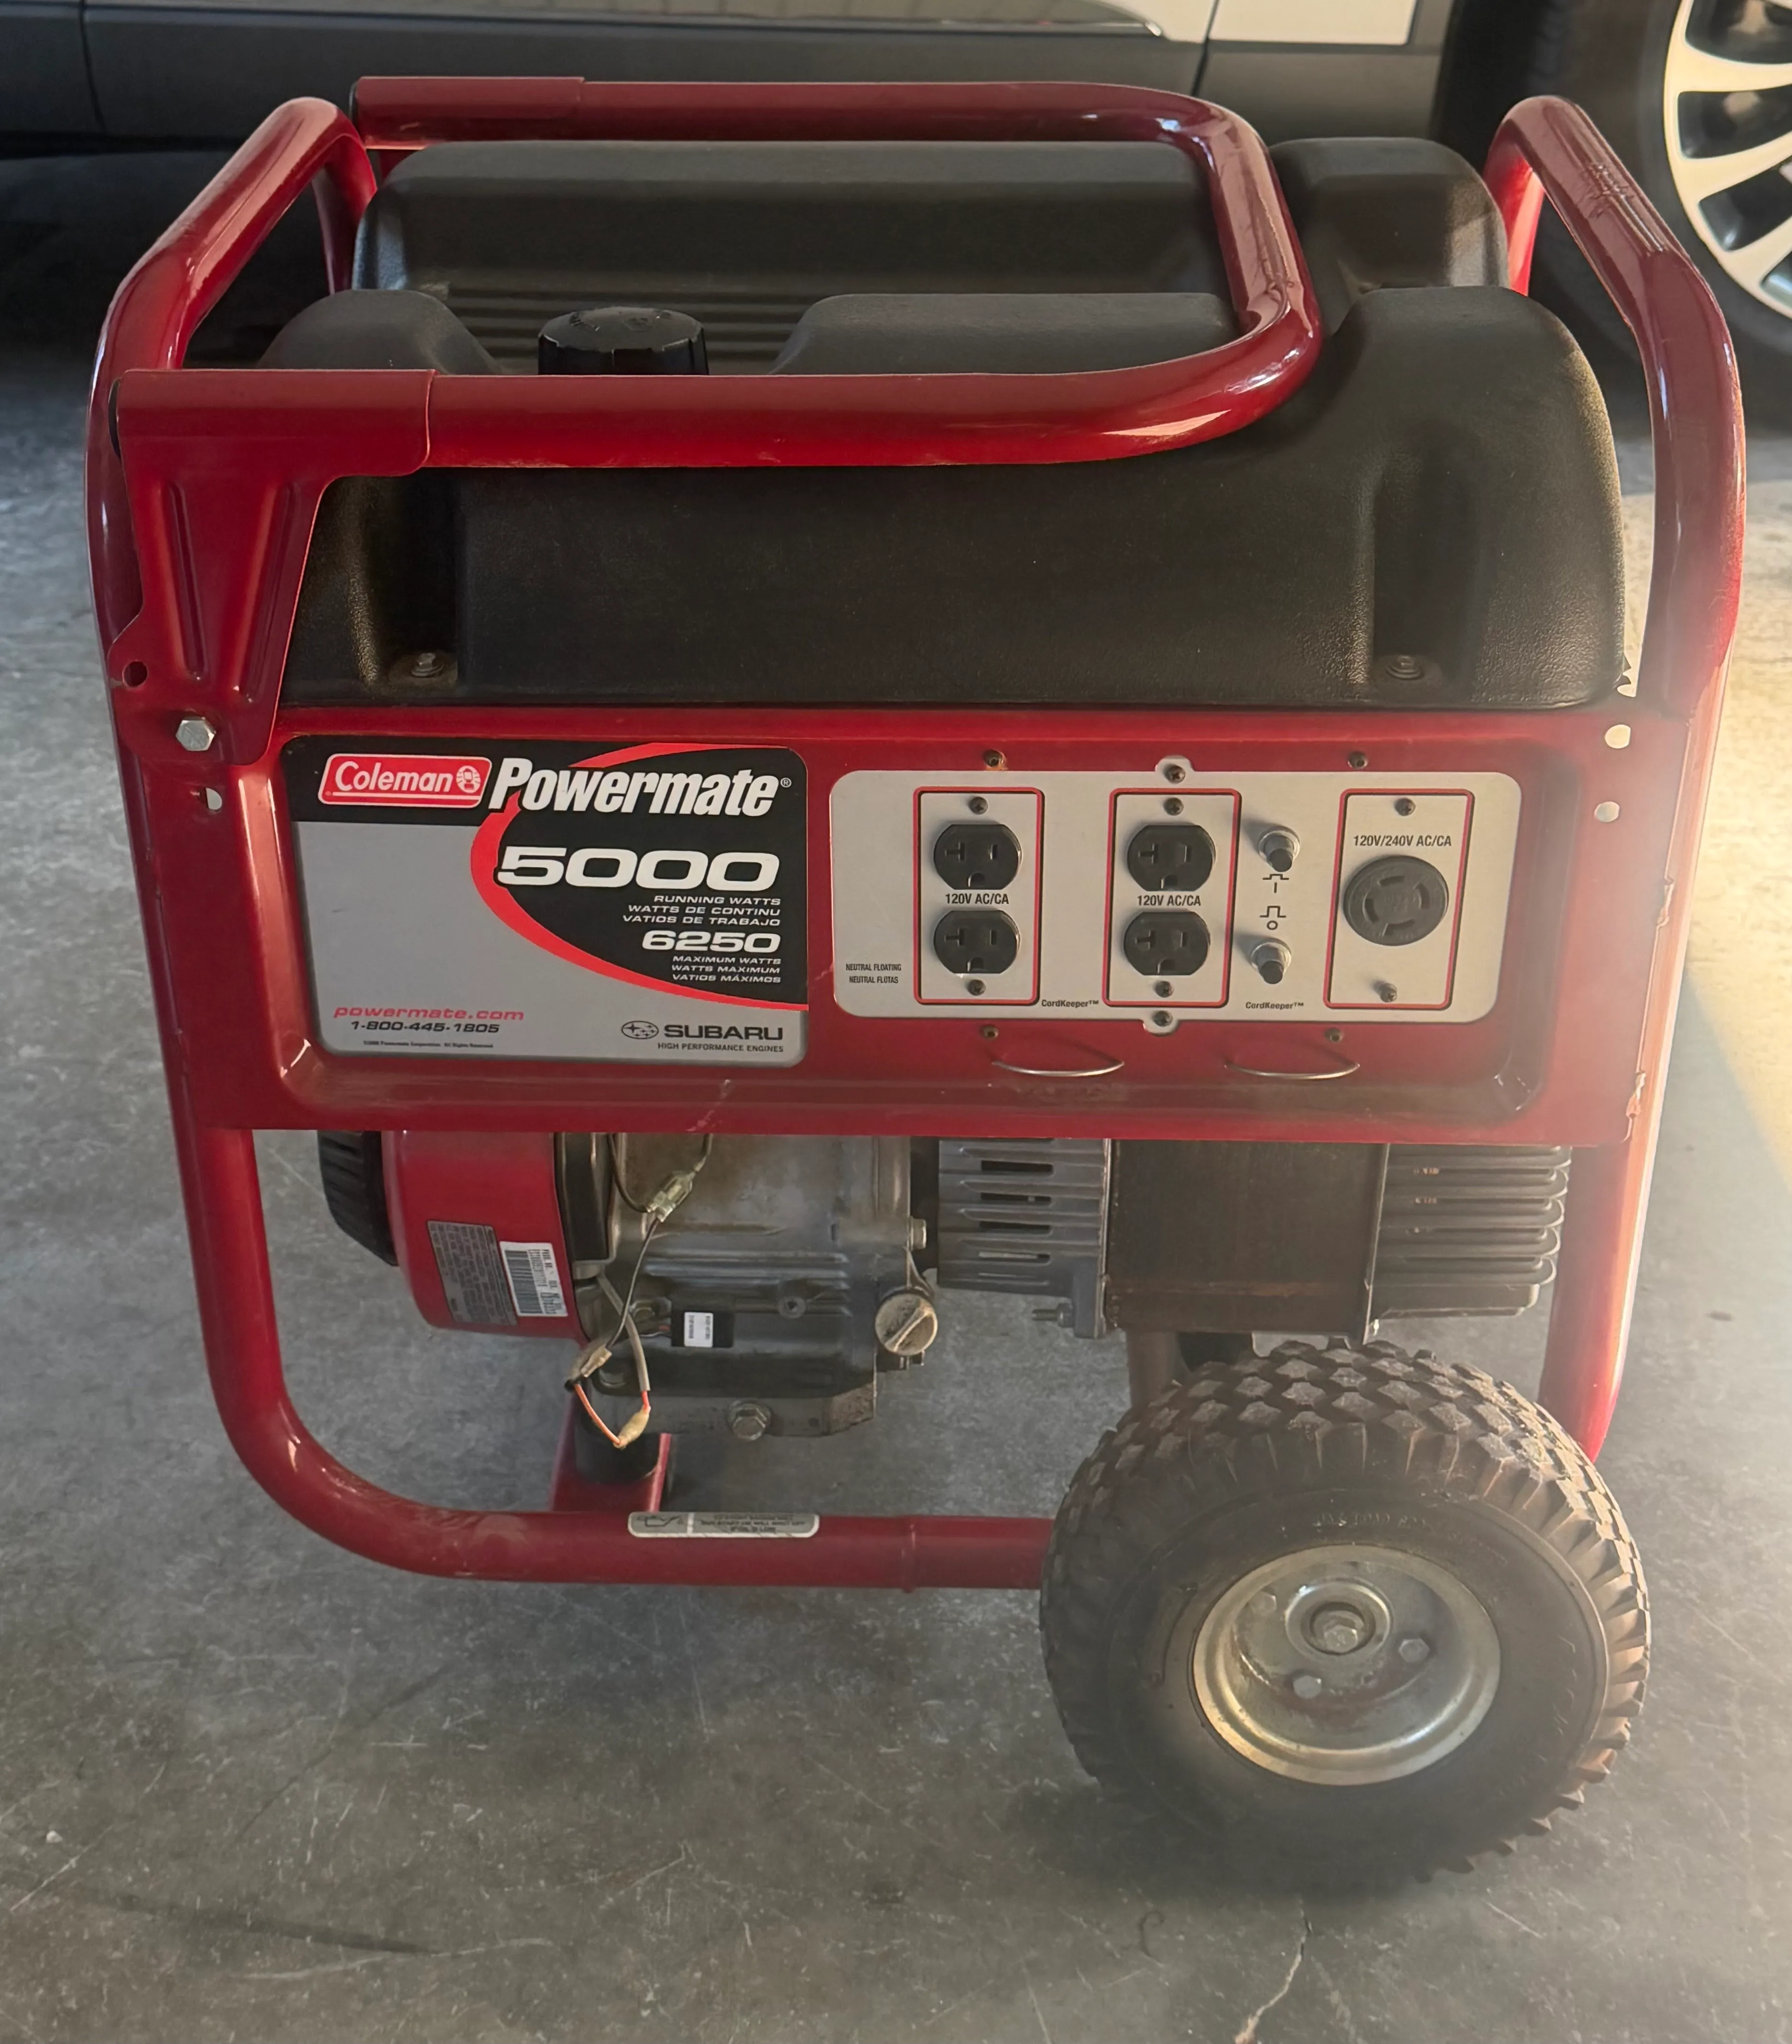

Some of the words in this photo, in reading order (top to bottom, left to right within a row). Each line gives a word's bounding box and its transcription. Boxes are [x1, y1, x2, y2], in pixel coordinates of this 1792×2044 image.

[336, 761, 453, 792] Coleman
[1354, 835, 1414, 847] 120V/240V
[1415, 835, 1452, 847] AC/CA
[497, 846, 779, 891] 5000
[654, 895, 725, 904] RUNNING
[730, 897, 781, 906] WATTS
[945, 893, 972, 904] 120V
[974, 893, 1009, 905] AC/CA
[1137, 895, 1164, 906] 120V
[1167, 895, 1201, 907] AC/CA
[628, 905, 680, 913] WATTS
[711, 907, 780, 916] CONTINU
[623, 915, 677, 923] VATIOS
[709, 917, 780, 926] TRABAJO
[642, 930, 781, 953] 6250
[846, 963, 872, 971] NEUTRAL
[873, 963, 901, 971] FLOATING
[849, 975, 875, 983] NEUTRAL
[876, 976, 898, 984] FLOTAS
[333, 1007, 524, 1020] powermate.com
[351, 1021, 500, 1033] 1-800-445-1805
[664, 1024, 783, 1040] SUBARU
[682, 1043, 744, 1052] PERFORMANCE
